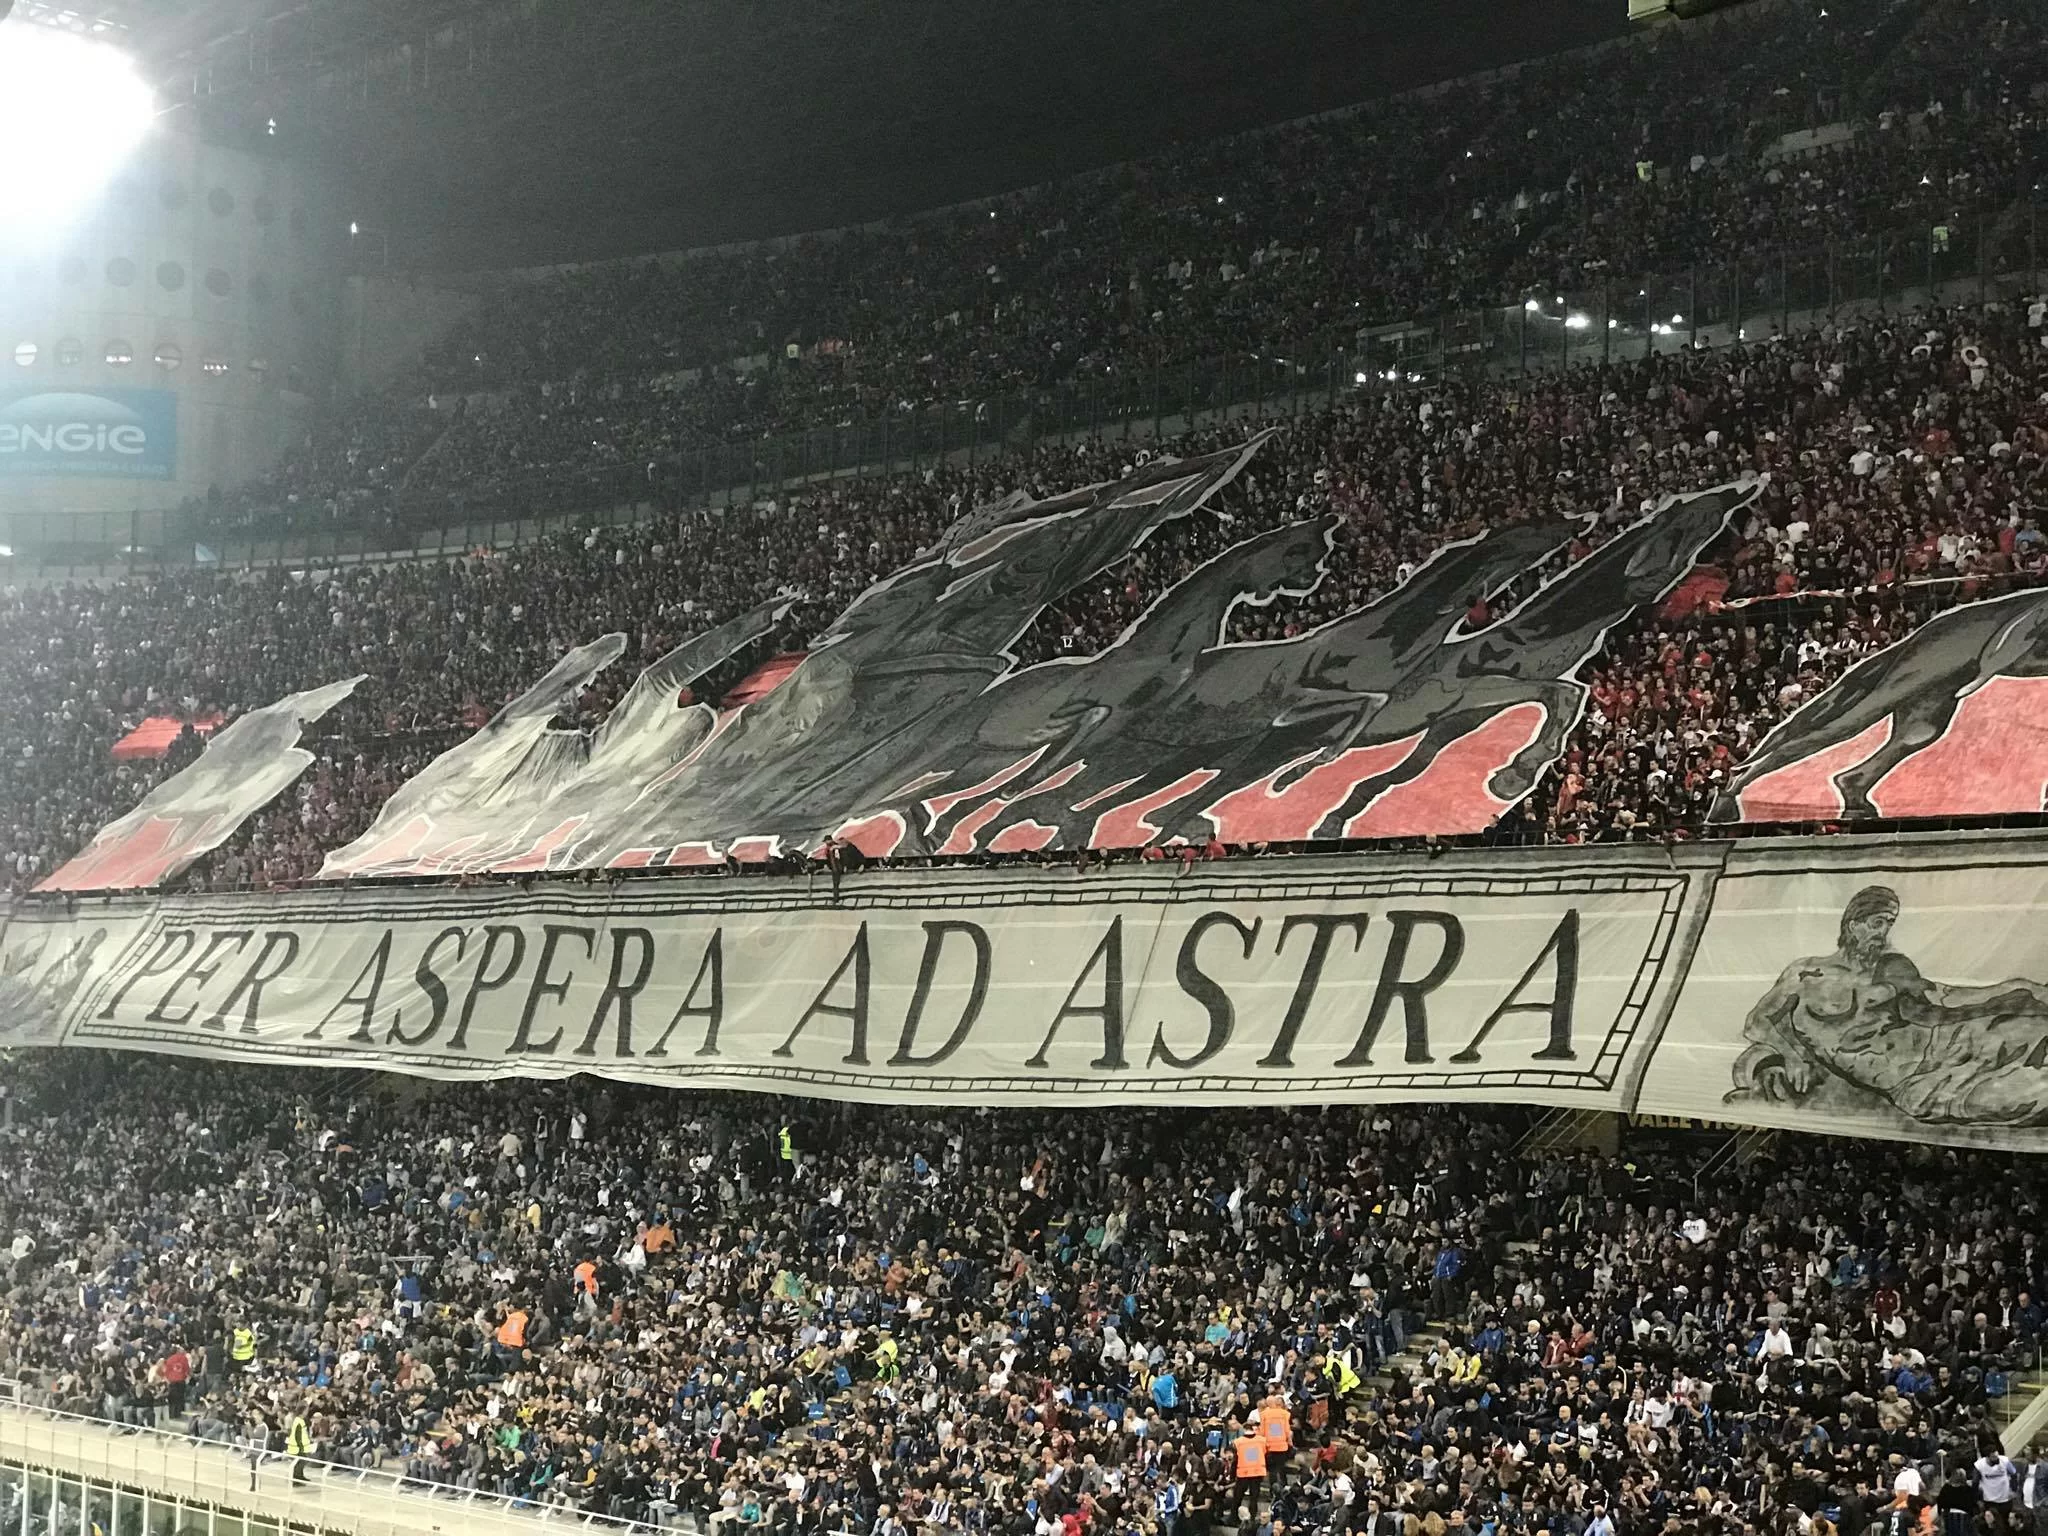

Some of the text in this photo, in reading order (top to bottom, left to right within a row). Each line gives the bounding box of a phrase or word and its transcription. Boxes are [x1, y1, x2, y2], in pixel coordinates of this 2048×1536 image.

[98, 909, 1579, 1070] PER ASPERA AD ASTRA
